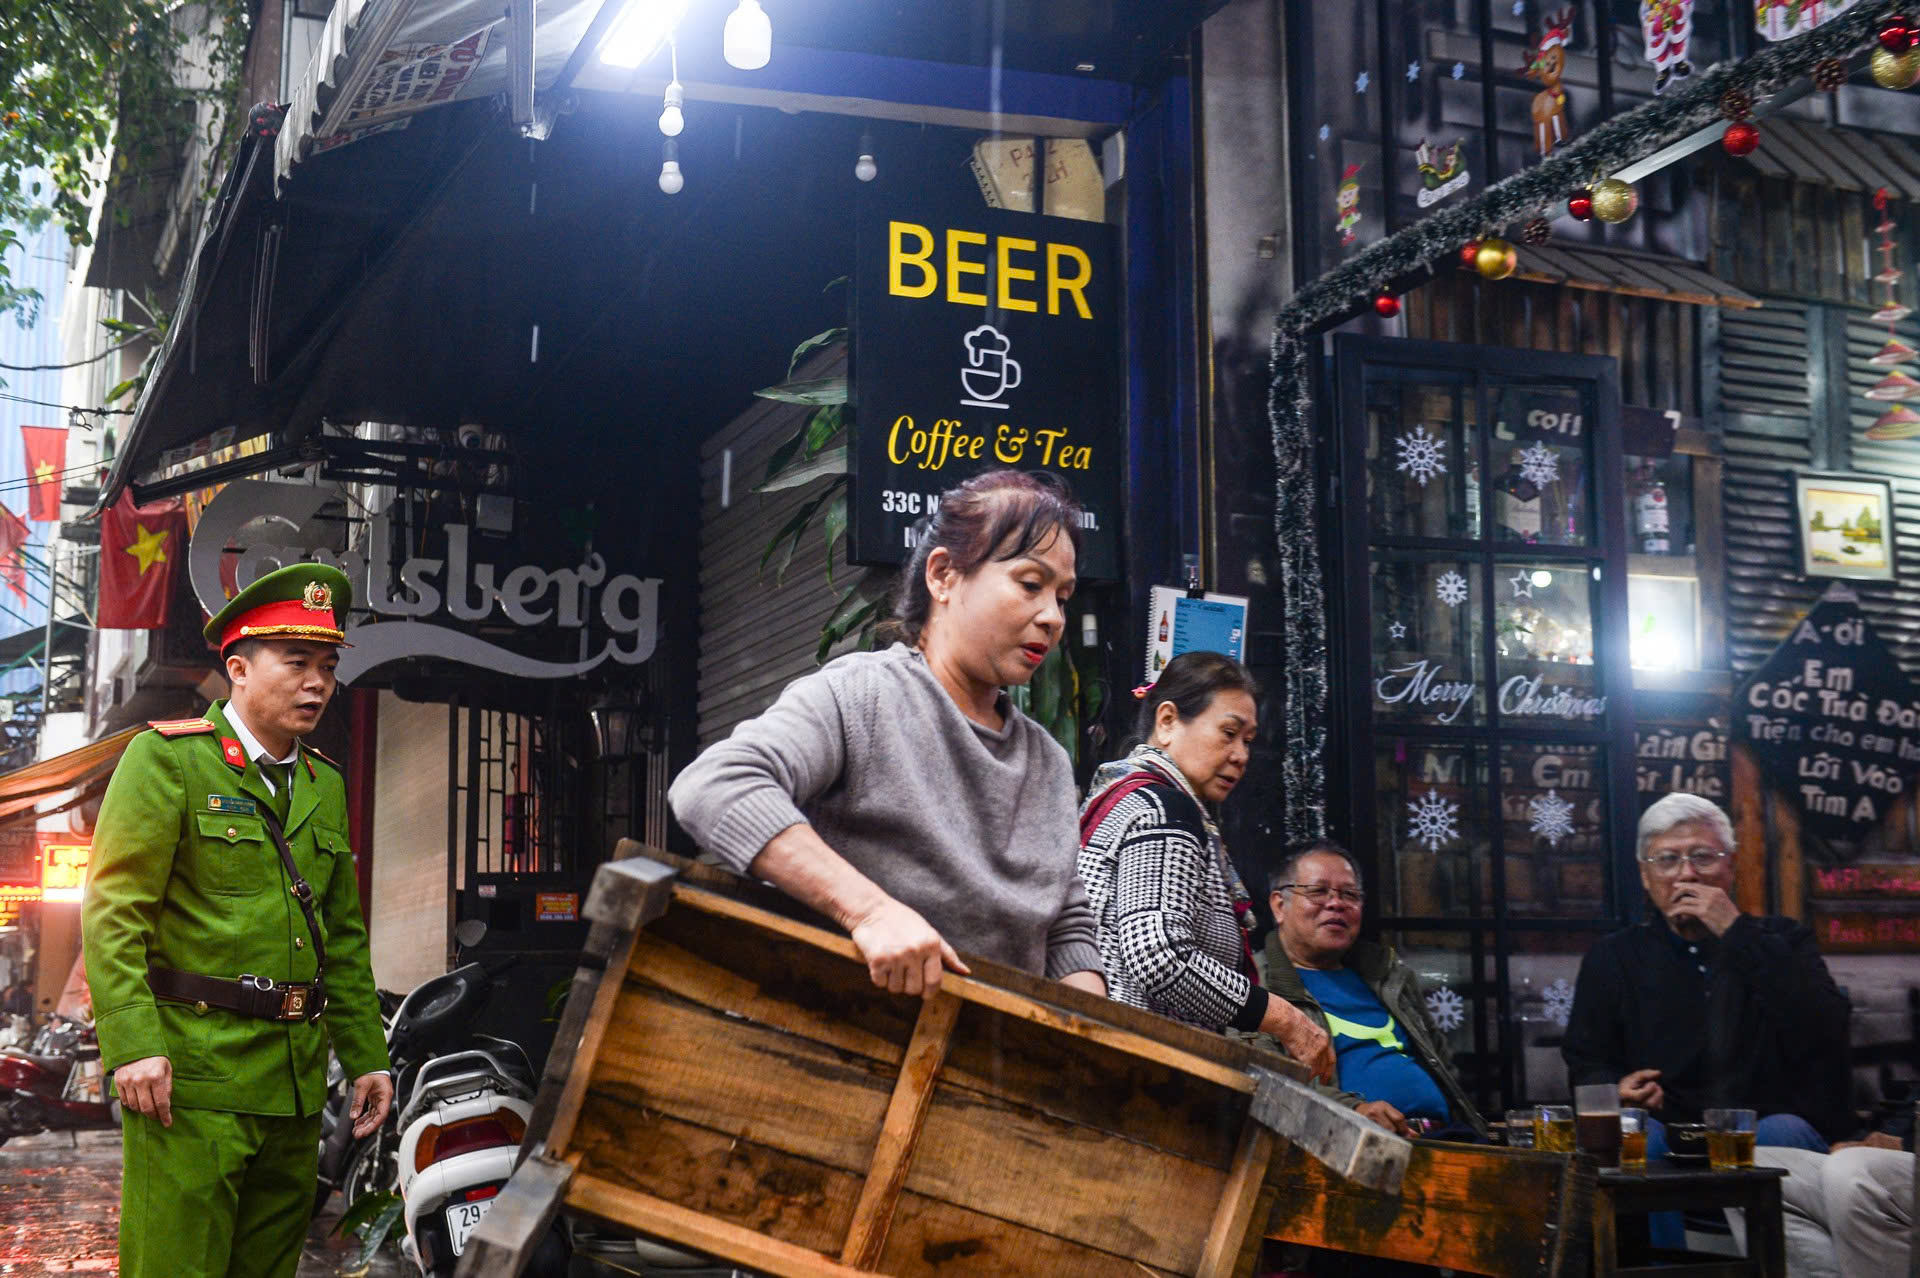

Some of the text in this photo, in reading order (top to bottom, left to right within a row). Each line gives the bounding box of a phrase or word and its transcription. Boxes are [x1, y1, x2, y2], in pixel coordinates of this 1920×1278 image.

[888, 220, 1094, 320] BEER
[887, 415, 1093, 471] Coffee & Tea
[882, 490, 921, 514] 33C
[1375, 659, 1609, 723] Merry Christmas
[1804, 658, 1854, 692] Em
[1810, 722, 1854, 747] cho
[1861, 733, 1896, 754] em
[1851, 794, 1877, 823] A
